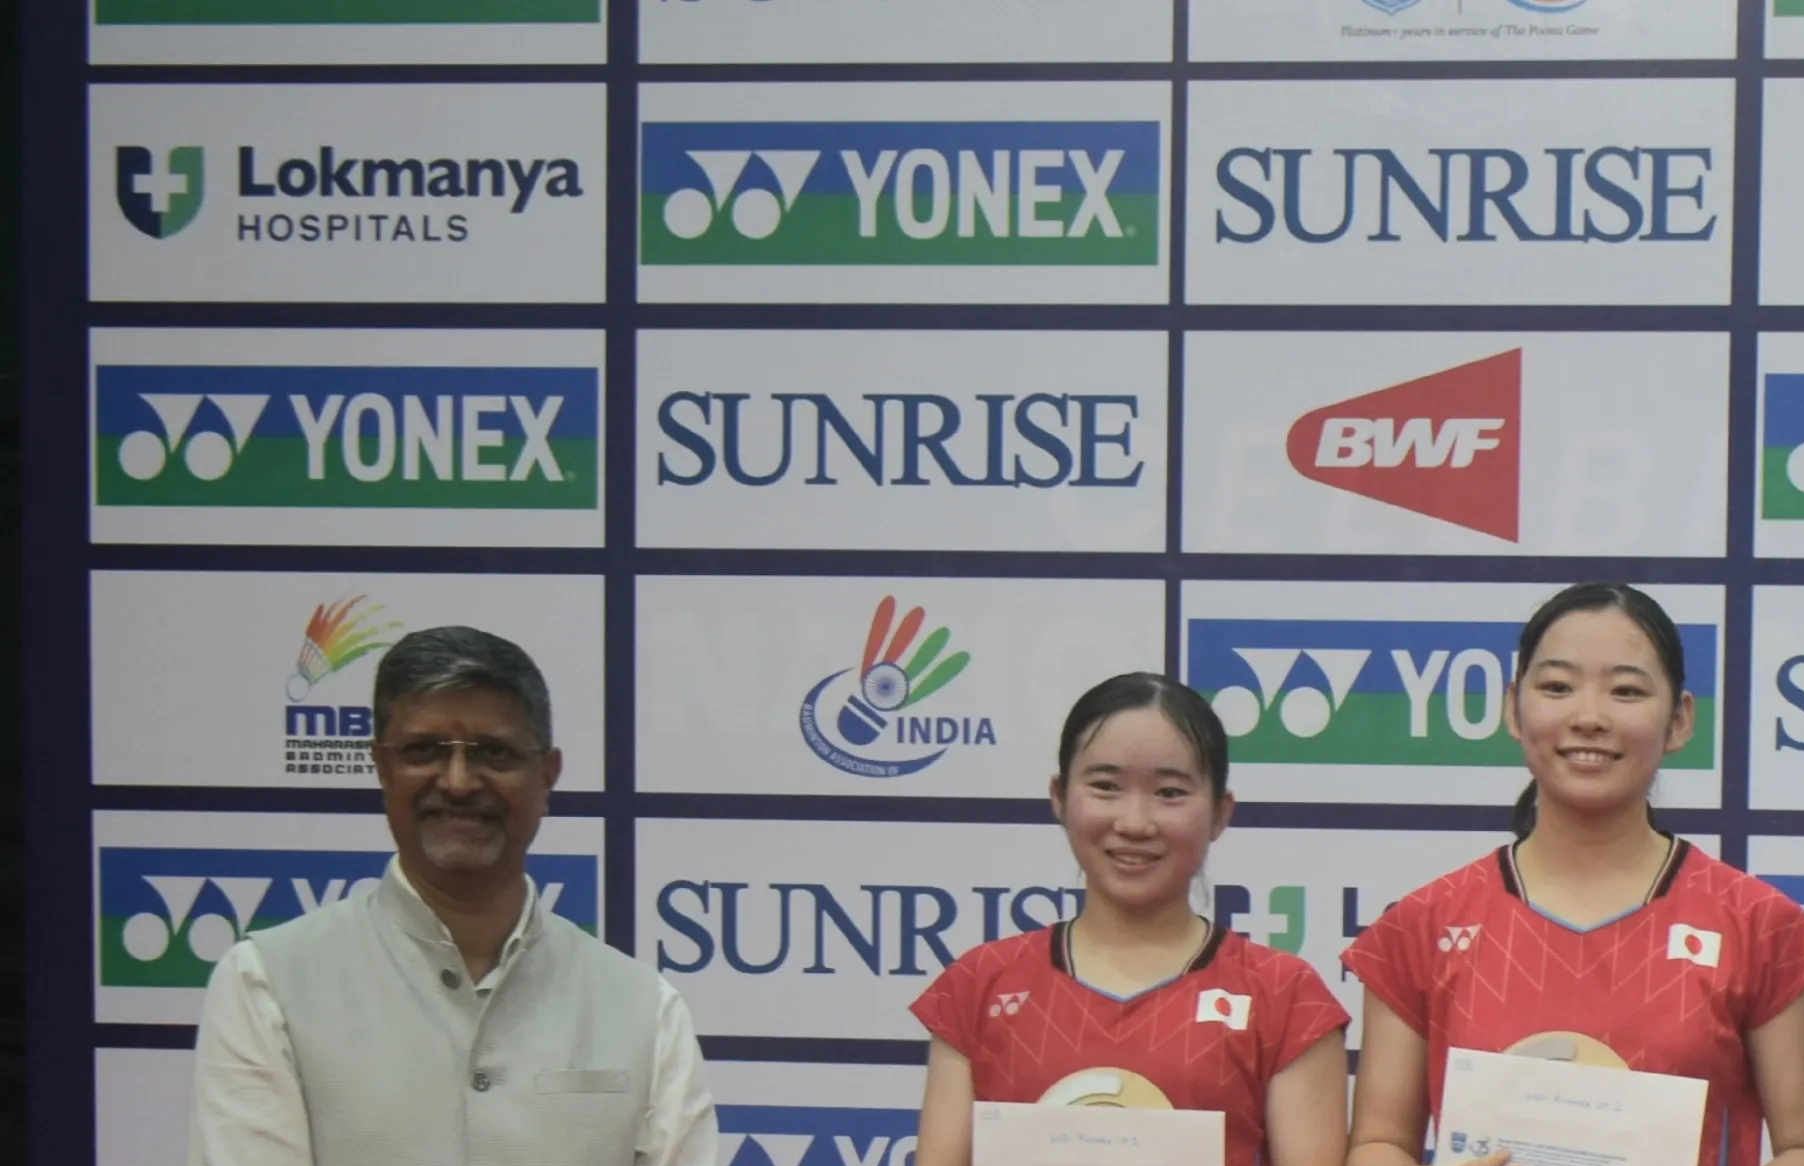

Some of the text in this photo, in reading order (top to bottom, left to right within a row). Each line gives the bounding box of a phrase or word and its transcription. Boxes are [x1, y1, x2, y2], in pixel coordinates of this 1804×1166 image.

[1400, 27, 1432, 40] years
[1434, 25, 1447, 36] in
[1449, 26, 1488, 37] service
[1490, 24, 1504, 40] of
[1505, 24, 1526, 36] The
[1566, 24, 1600, 36] Game
[239, 146, 583, 213] Lokmanya
[841, 149, 1125, 240] YONEX
[1216, 146, 1717, 244] SUNRISE
[239, 215, 469, 242] HOSPITALS
[290, 392, 565, 482] YONEX
[657, 390, 1144, 489] SUNRISE
[1315, 417, 1506, 469] BWF
[285, 751, 373, 761] BADMIN
[897, 716, 997, 745] INDIA
[285, 763, 376, 775] ASSOCIAT
